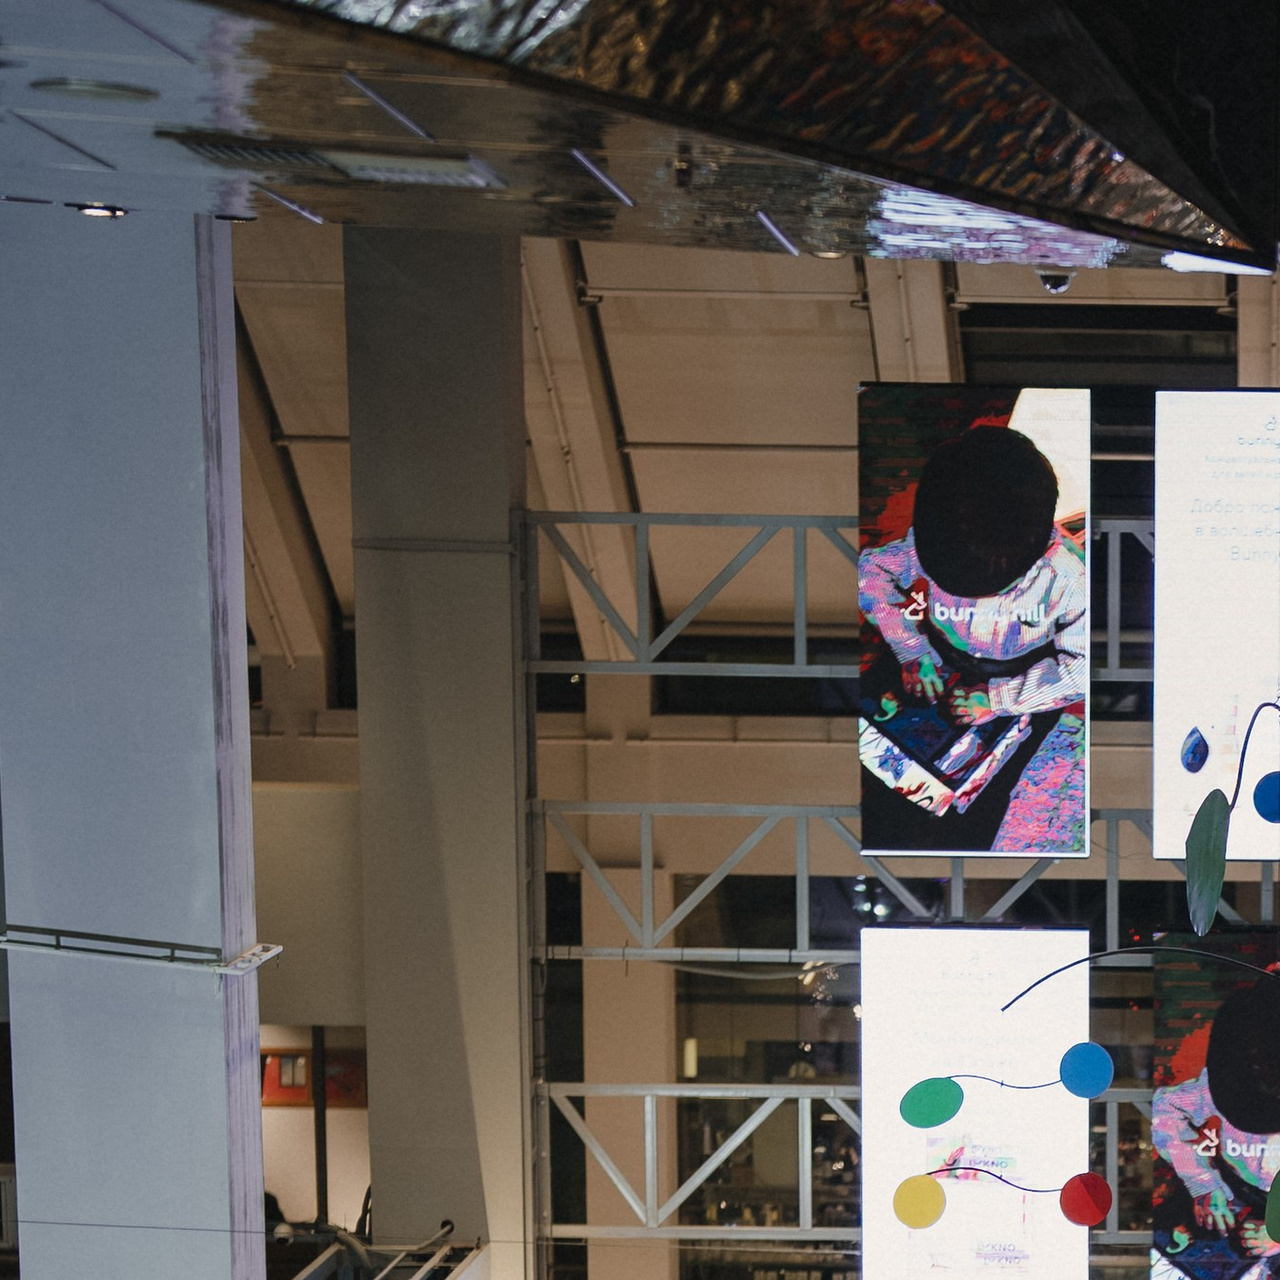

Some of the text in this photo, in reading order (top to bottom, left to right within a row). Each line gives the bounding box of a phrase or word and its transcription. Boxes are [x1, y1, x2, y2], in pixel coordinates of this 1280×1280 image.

[1237, 435, 1280, 449] bunny
[1189, 498, 1245, 516] Добро
[1195, 526, 1204, 537] в
[1230, 545, 1280, 563] Bunny
